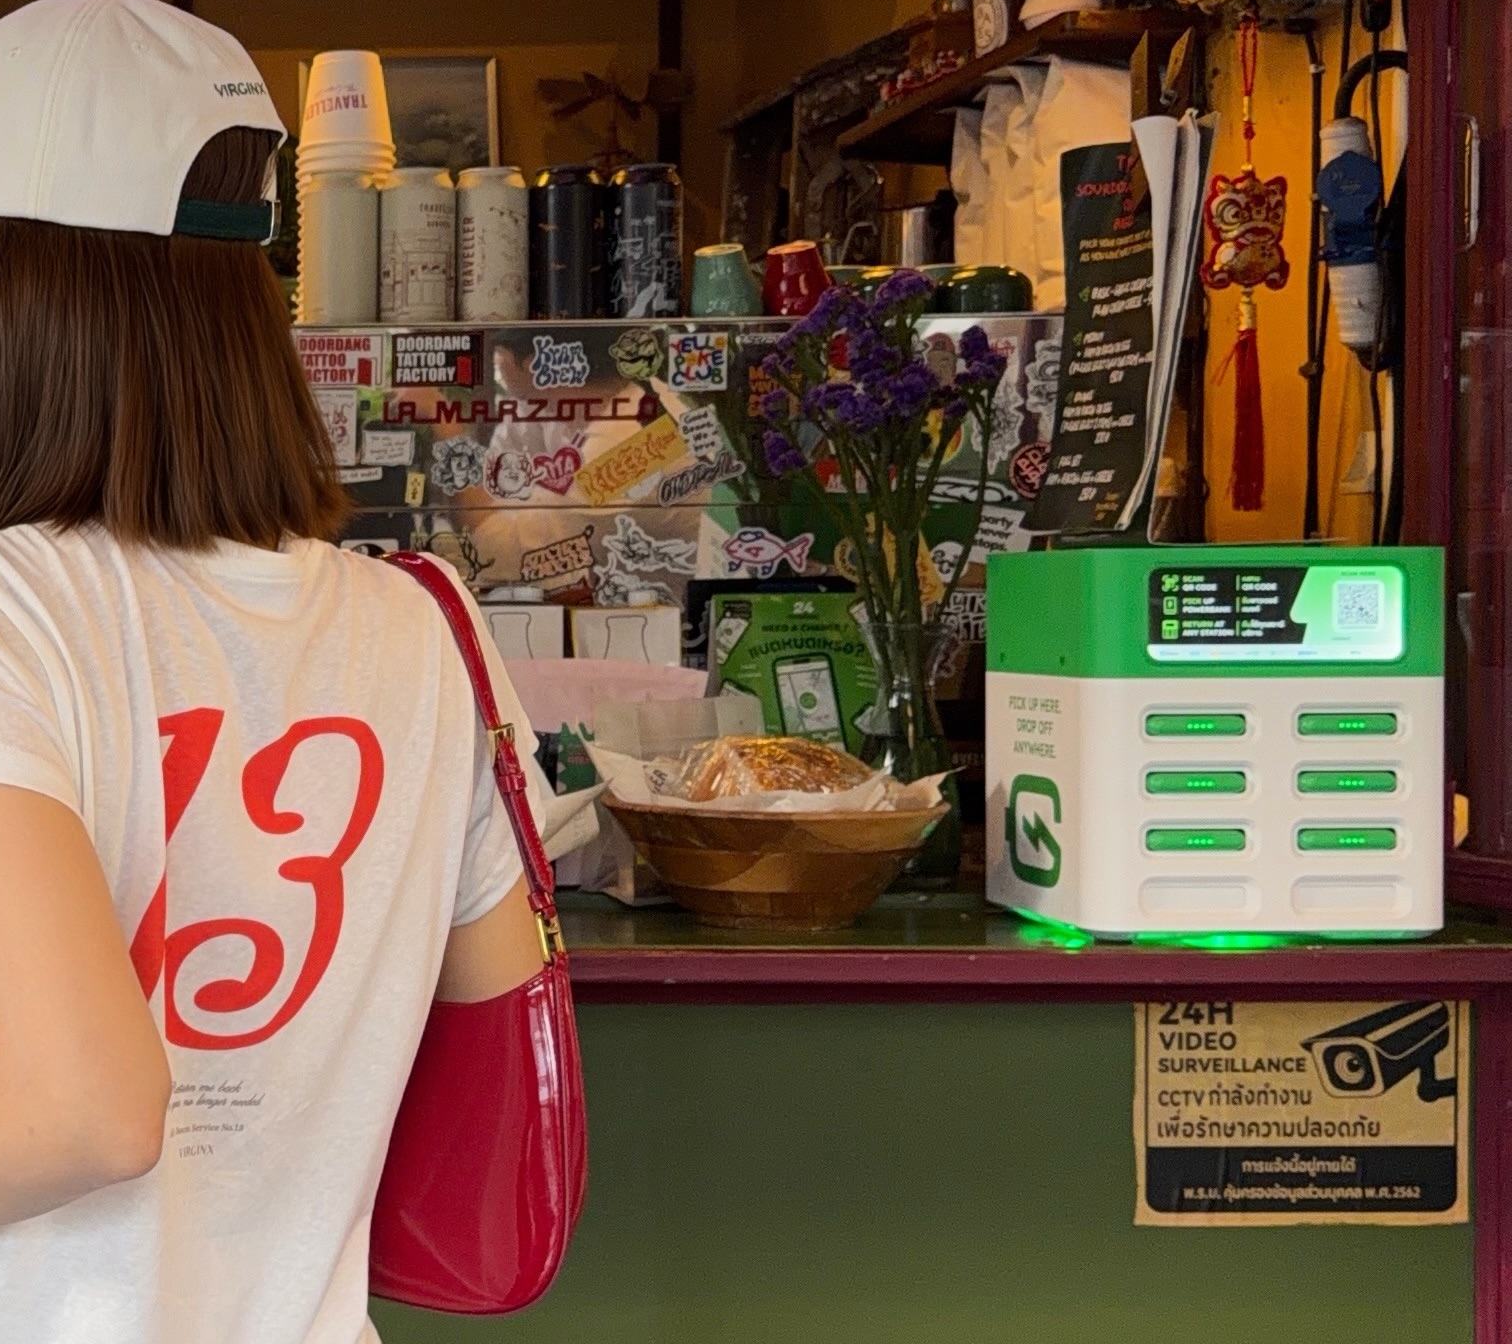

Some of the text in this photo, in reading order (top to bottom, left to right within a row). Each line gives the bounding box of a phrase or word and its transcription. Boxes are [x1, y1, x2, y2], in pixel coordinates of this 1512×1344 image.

[214, 82, 268, 98] VIRGINX
[462, 216, 476, 294] TRAVELLER
[299, 338, 371, 352] DOORDANG
[396, 335, 471, 352] DOORDANG
[396, 352, 446, 368] TATTOO
[306, 368, 356, 383] ACTORY
[396, 367, 456, 383] FACTORY
[672, 364, 724, 386] CLUB
[383, 400, 416, 425] LA
[980, 515, 1015, 531] party
[978, 528, 1012, 539] never
[1009, 695, 1026, 710] PICK
[1028, 697, 1038, 711] UP
[1017, 718, 1053, 736] DROP OFF
[130, 706, 385, 1051] 13
[1158, 1002, 1234, 1026] 24H
[1159, 1032, 1237, 1051] VIDEO
[1158, 1057, 1307, 1073] SURVEILLANCE
[1158, 1082, 1312, 1107] CCTV กำลังทำงาน
[191, 1123, 219, 1133] Service
[1157, 1109, 1381, 1139] เพื่อรักษาความปลอดภัย
